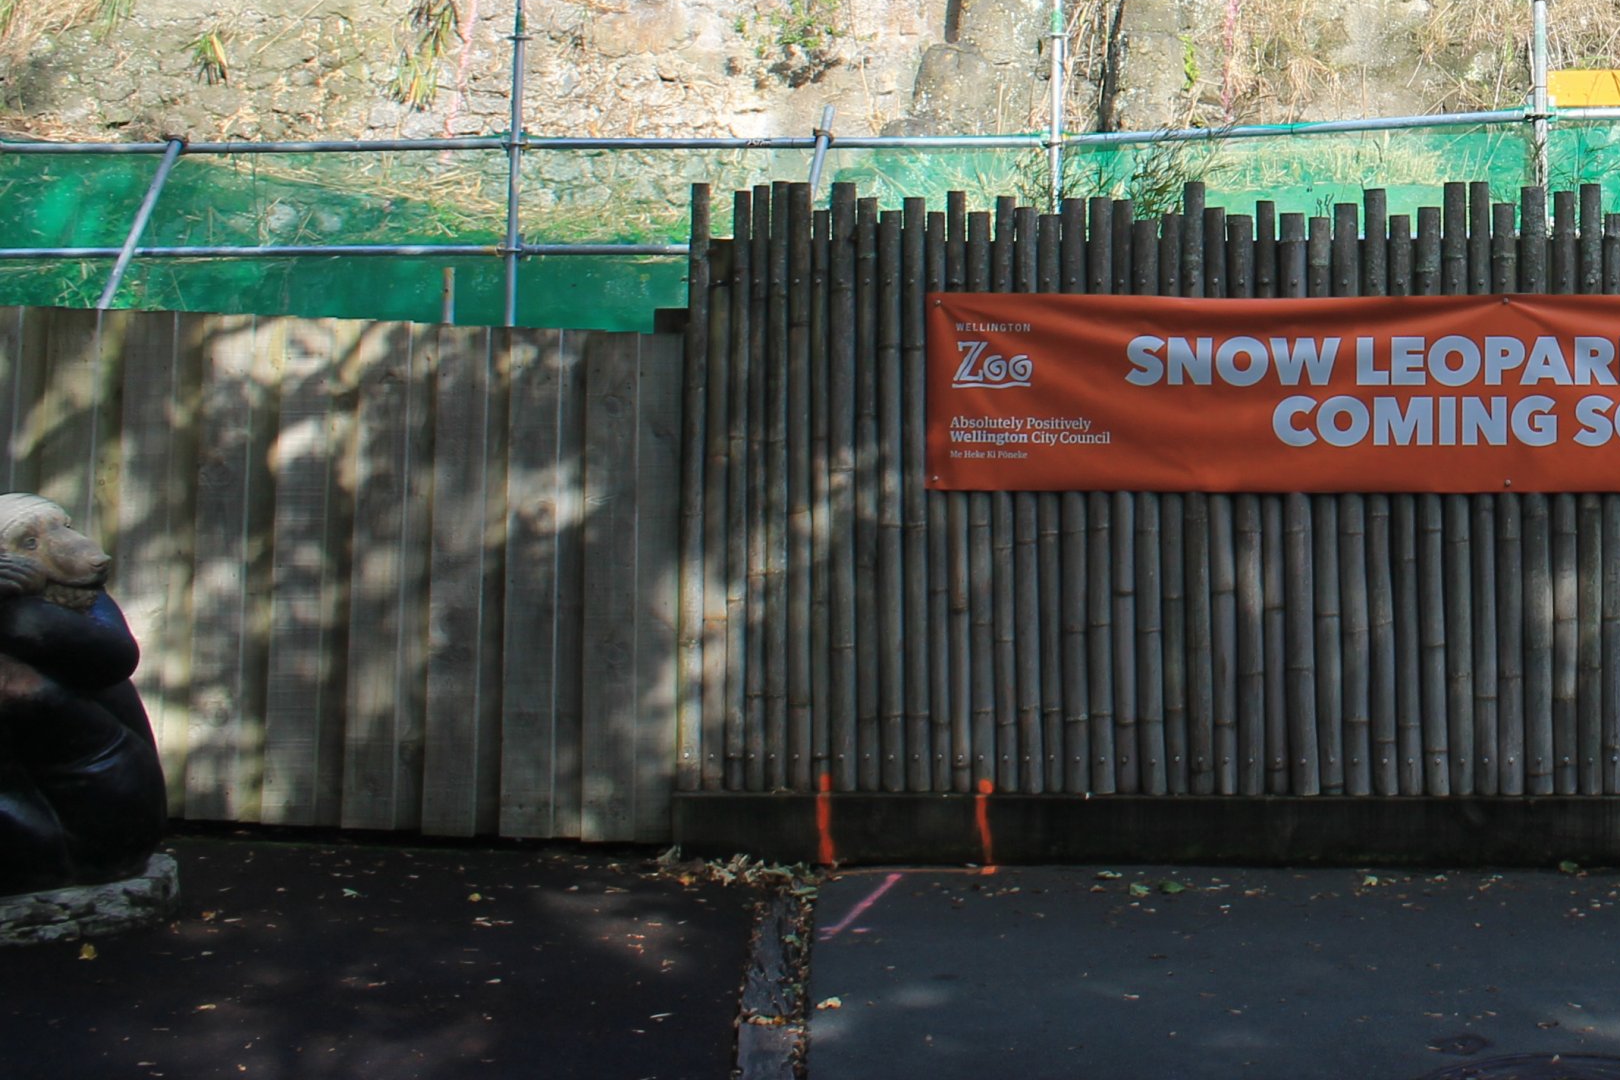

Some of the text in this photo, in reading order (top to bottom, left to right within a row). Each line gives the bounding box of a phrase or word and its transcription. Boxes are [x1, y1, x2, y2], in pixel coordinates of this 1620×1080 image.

[956, 323, 1031, 332] WELLINGTON
[1124, 335, 1342, 387] SNOW
[950, 416, 1091, 432] Absolutely Positively
[1271, 395, 1558, 447] COMING
[950, 430, 1111, 446] Wellington City Council
[963, 450, 985, 459] Heke
[986, 450, 996, 459] Ki
